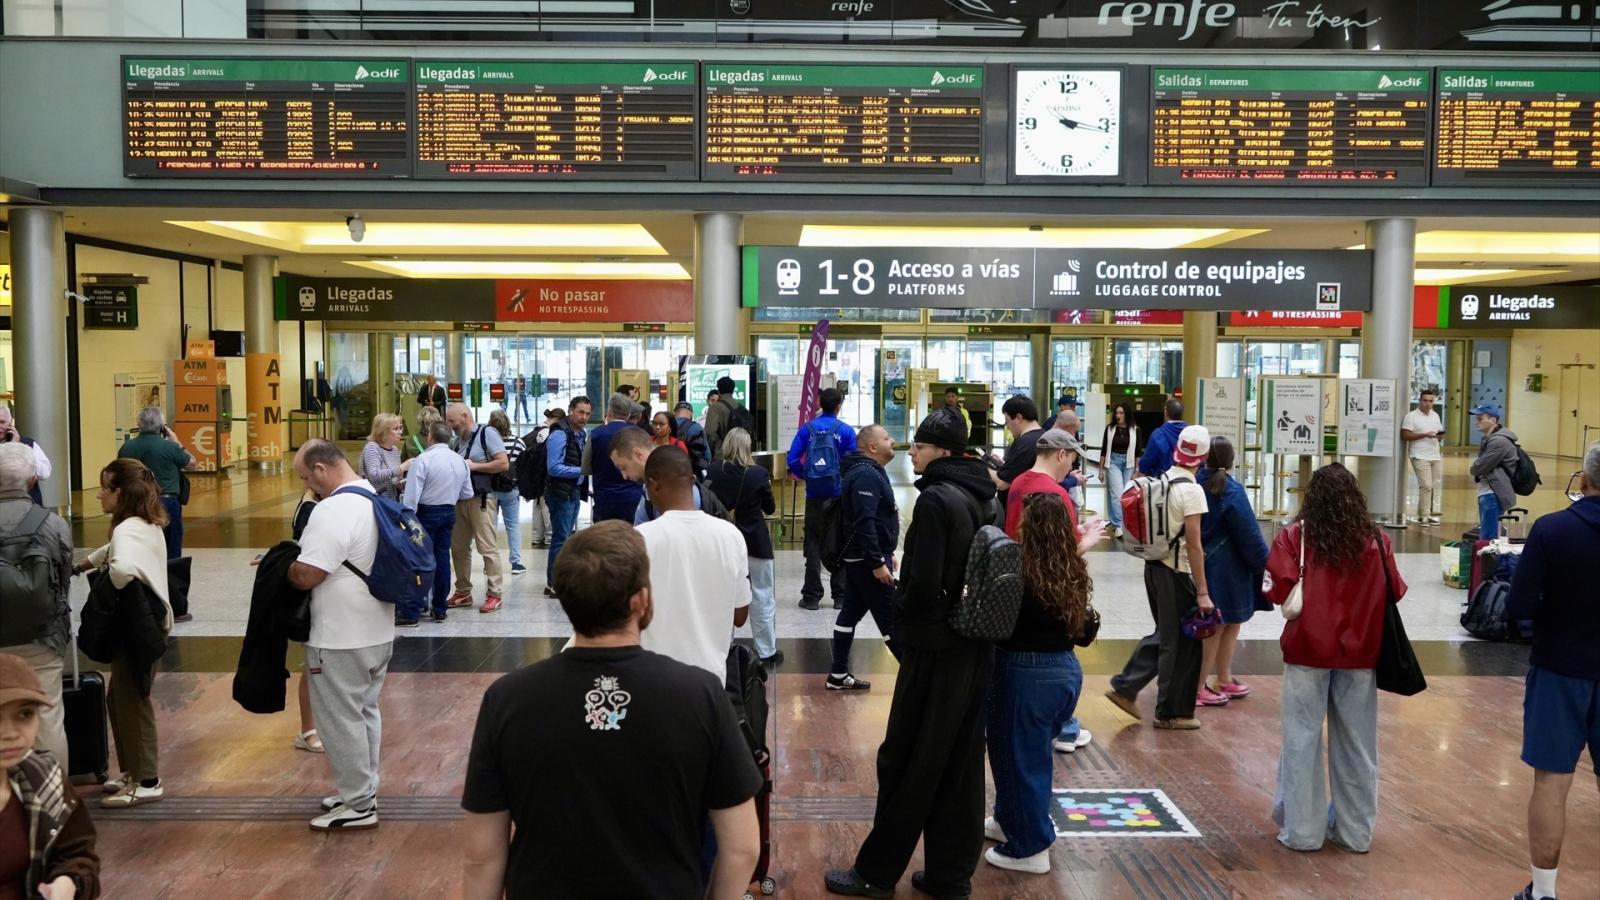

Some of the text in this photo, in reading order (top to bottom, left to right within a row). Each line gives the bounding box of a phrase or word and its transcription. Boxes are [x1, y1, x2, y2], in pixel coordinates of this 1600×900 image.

[831, 0, 874, 16] renfe
[1097, 0, 1374, 40] renfe Tu tren
[129, 64, 185, 79] Llegadas
[370, 68, 400, 78] adif
[420, 68, 475, 81] Llegadas
[659, 71, 687, 81] adif
[710, 70, 764, 84] Llegadas
[947, 73, 975, 83] adif
[1159, 75, 1202, 86] Salidas
[1393, 77, 1423, 87] adif
[1444, 76, 1488, 87] Salidas
[1059, 81, 1078, 94] 12
[1025, 117, 1110, 130] 9 3
[1061, 154, 1073, 167] 6
[817, 259, 1020, 296] 1-8 Acceso a vías
[1095, 260, 1305, 284] Control de equipajes
[328, 286, 393, 303] Llegadas
[888, 283, 965, 296] PLATFORMS
[1095, 284, 1222, 297] LUGGAGE CONTROL
[539, 288, 606, 305] No pasar
[1489, 295, 1555, 311] Llegadas
[329, 304, 369, 313] ARRIVALS
[539, 306, 609, 314] NO TRESPASSING
[1272, 311, 1342, 319] NO TRESPASSING
[117, 311, 127, 323] H
[184, 362, 207, 370] ATM
[264, 359, 282, 425] ATM
[184, 404, 209, 413] ATM
[249, 441, 280, 457] ash
